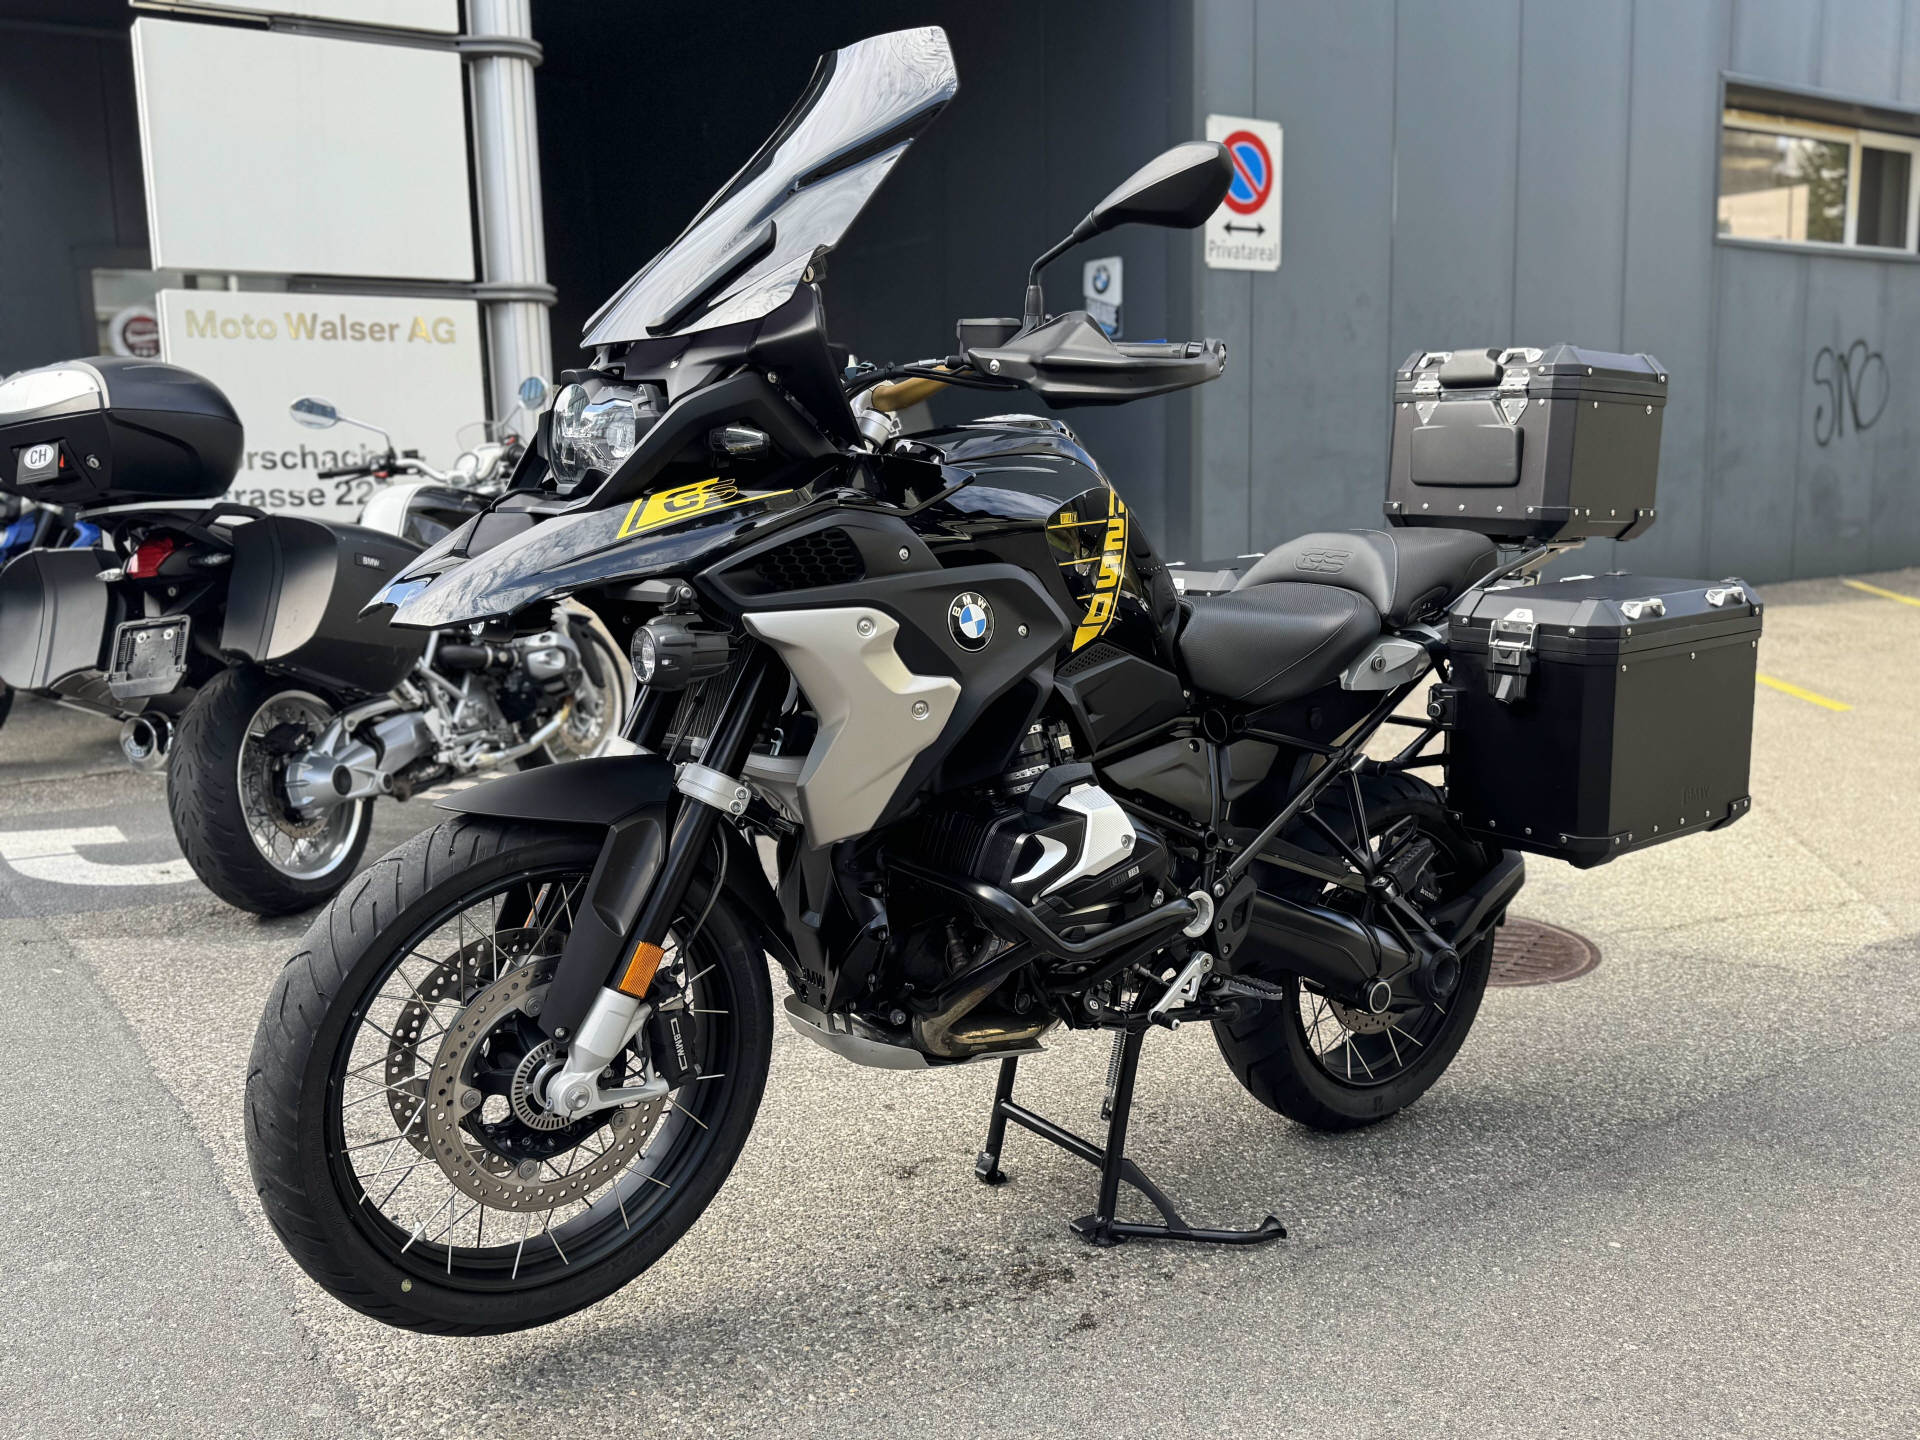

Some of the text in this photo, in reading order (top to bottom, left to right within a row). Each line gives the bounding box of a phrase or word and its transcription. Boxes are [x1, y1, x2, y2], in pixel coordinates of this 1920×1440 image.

[1209, 238, 1278, 261] Privatareal
[184, 310, 457, 344] Moto Walser AG
[30, 448, 47, 465] CH
[240, 443, 378, 470] rschac
[362, 555, 381, 567] BMW
[952, 594, 987, 617] BMW
[673, 1033, 685, 1057] BMW
